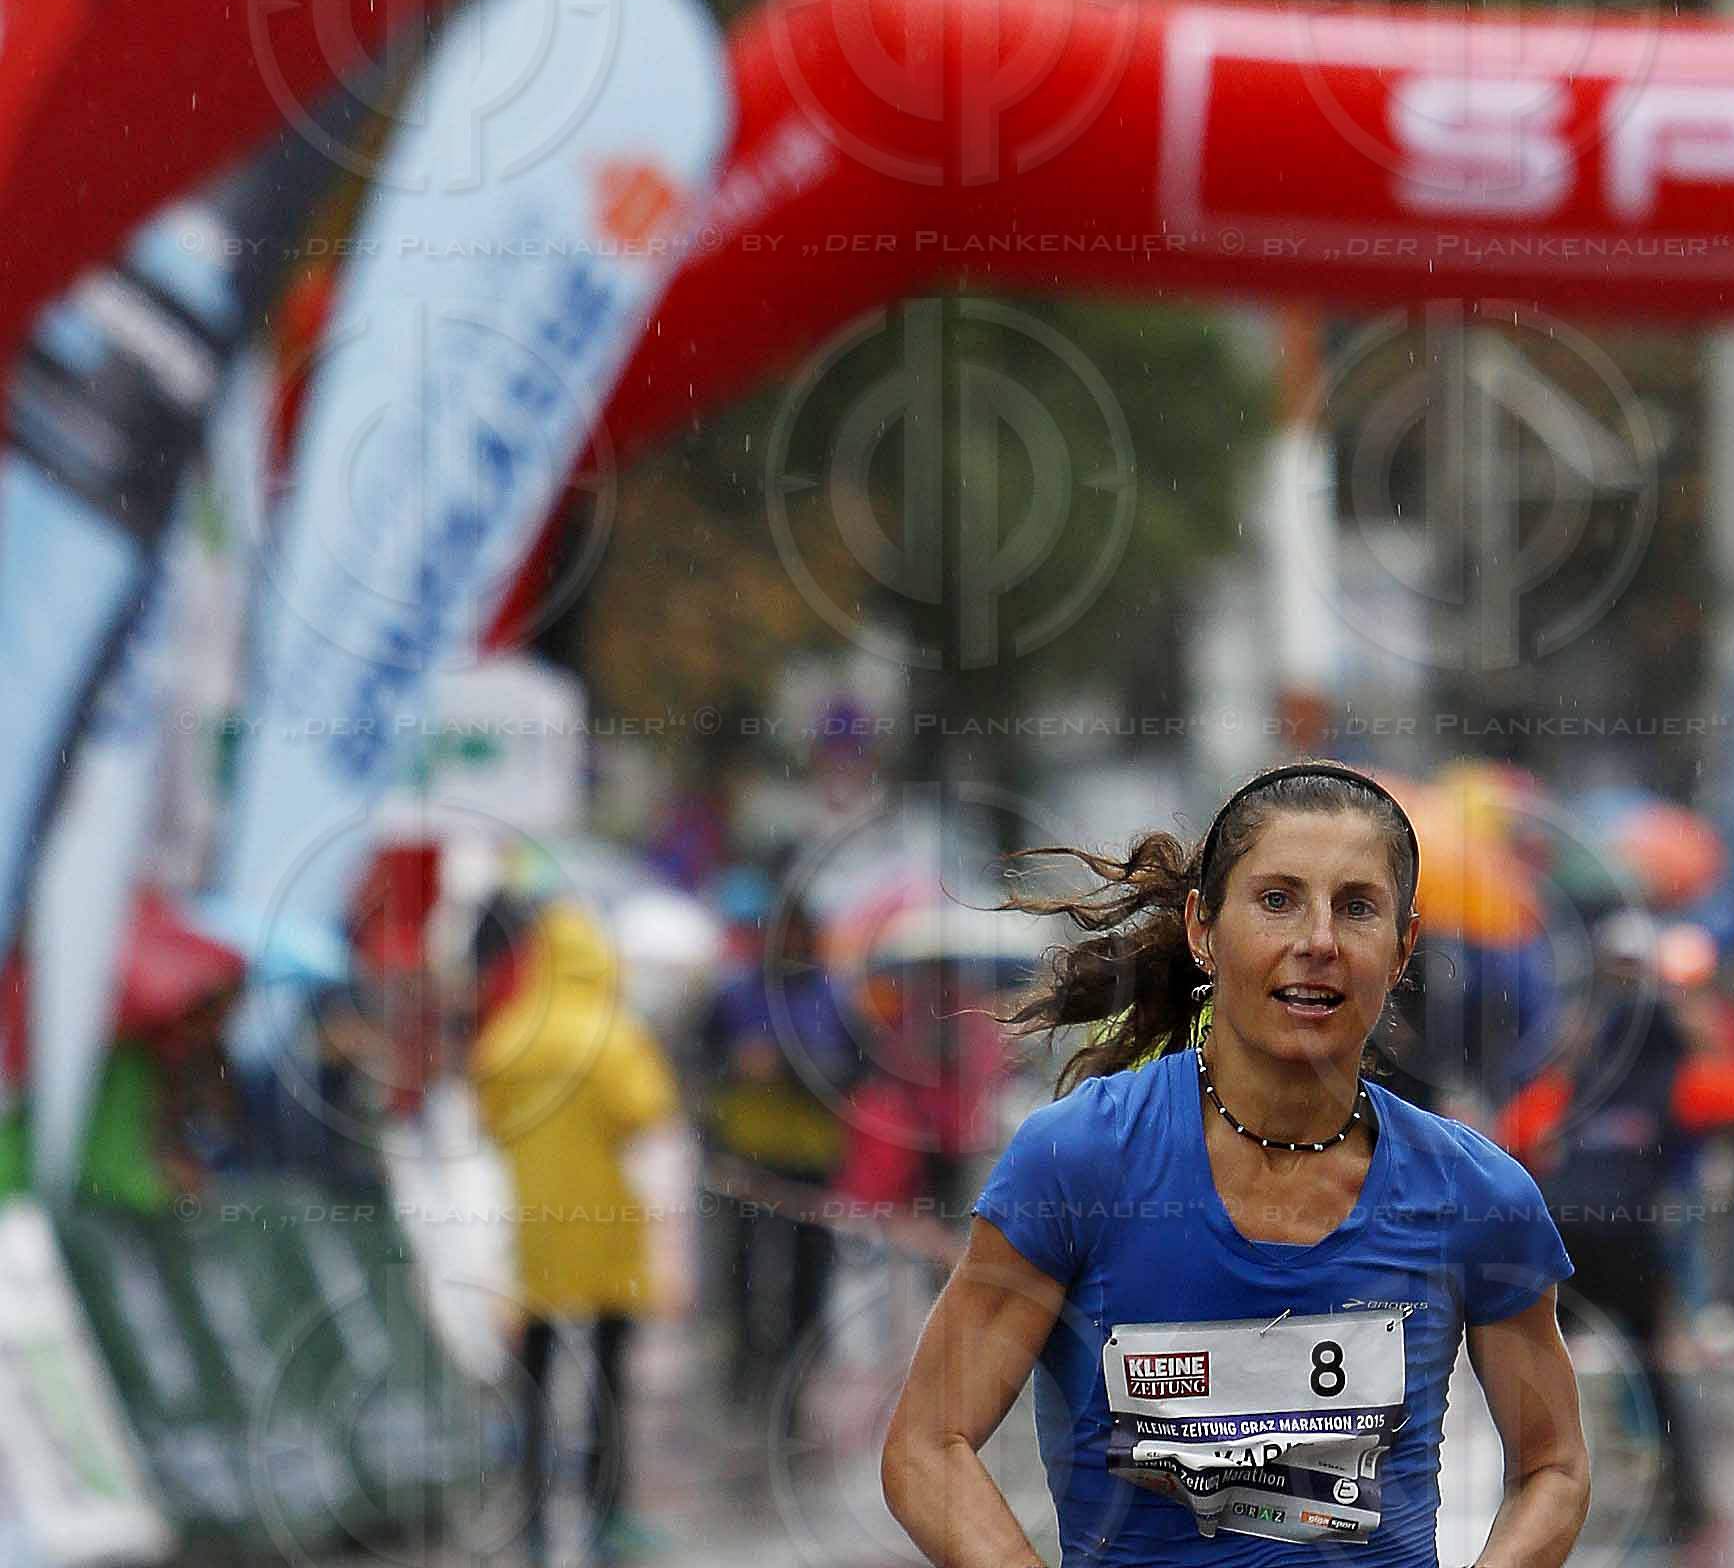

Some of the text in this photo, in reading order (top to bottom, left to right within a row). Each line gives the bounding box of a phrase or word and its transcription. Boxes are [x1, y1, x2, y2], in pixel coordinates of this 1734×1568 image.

[1127, 1356, 1205, 1377] KLEINE
[1309, 1340, 1347, 1398] 8
[1130, 1379, 1206, 1396] ZEITUNG
[1136, 1414, 1385, 1437] KLEINE ZEITUNG GRAZ MARATHON 2015
[1222, 1467, 1286, 1487] Marathon
